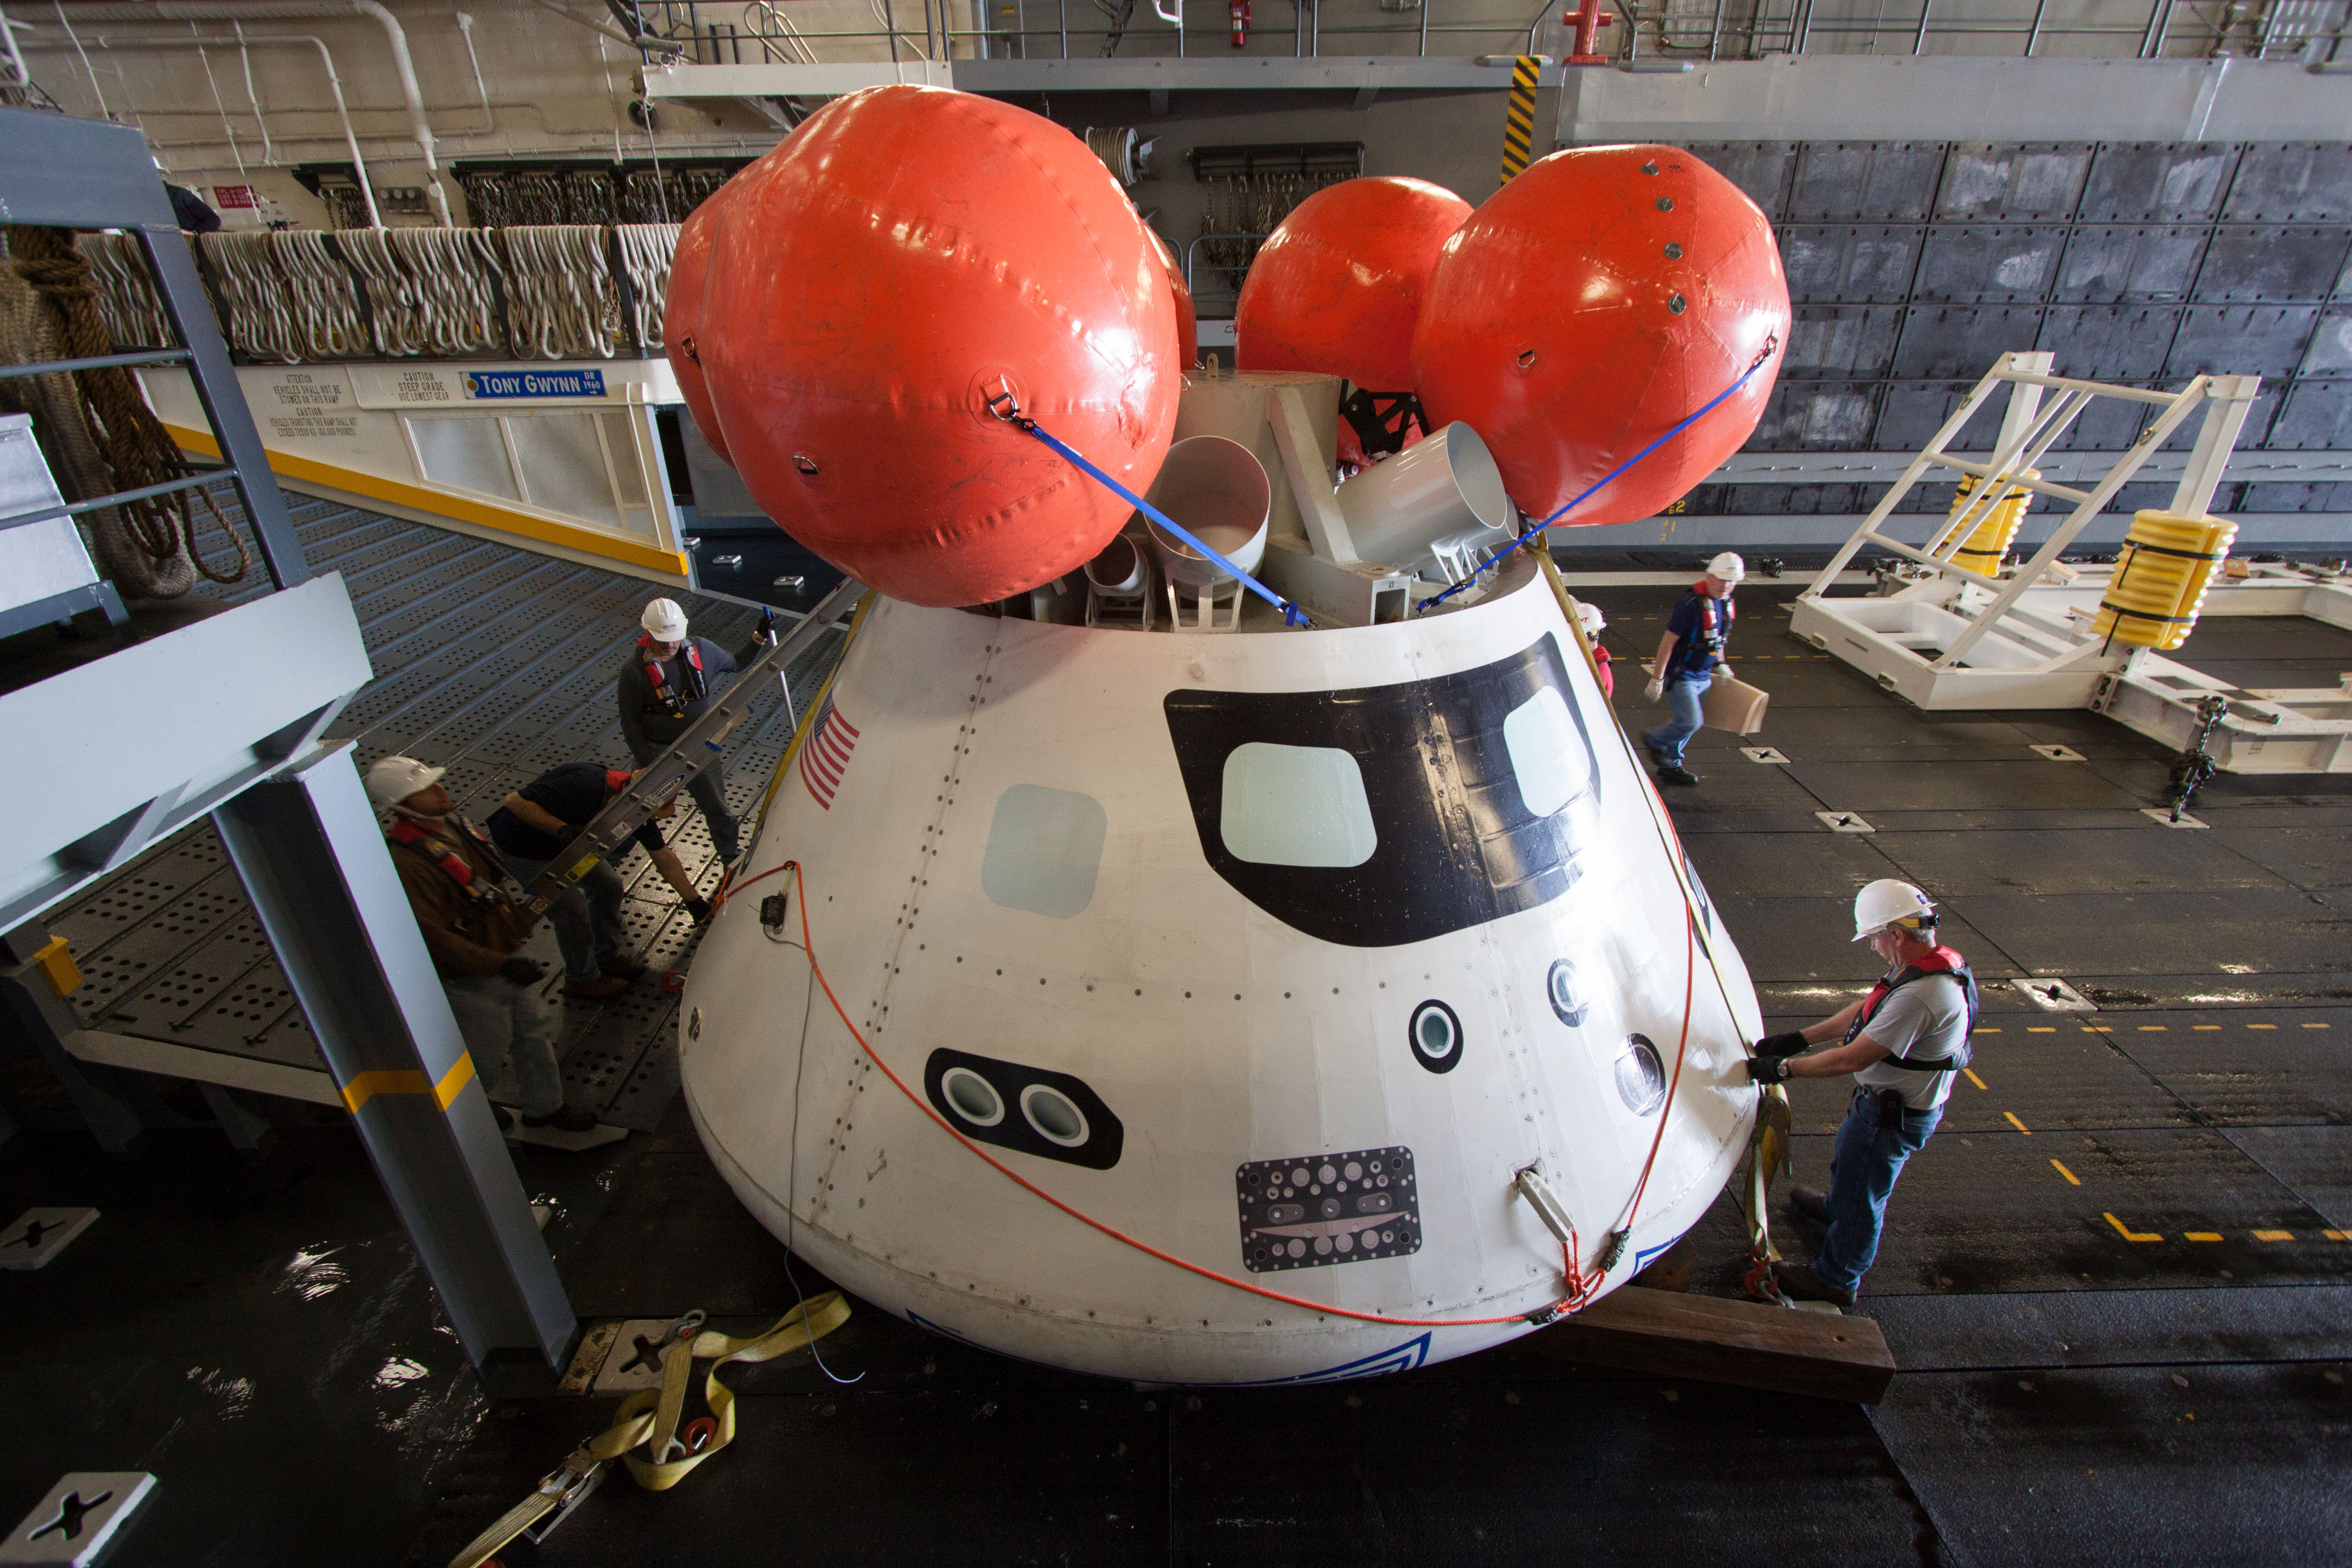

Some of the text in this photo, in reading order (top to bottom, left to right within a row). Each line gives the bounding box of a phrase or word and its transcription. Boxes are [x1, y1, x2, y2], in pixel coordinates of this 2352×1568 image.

[286, 374, 313, 384] ATTENTION
[404, 372, 435, 381] CAUTION
[398, 382, 445, 392] STEEP GRADE
[480, 374, 581, 394] TONY GWYNN
[583, 381, 600, 390] 1960
[273, 385, 342, 395] VEHICLES SHALL NOT BE
[280, 395, 339, 404] STOWED ON THIS RAMP
[398, 392, 450, 401] USE LOWEST GEAR
[296, 407, 322, 416] CAUTION
[323, 417, 335, 426] RAMP
[335, 417, 349, 426] SHALL
[1676, 500, 1685, 513] 2
[657, 779, 679, 797] WERNER
